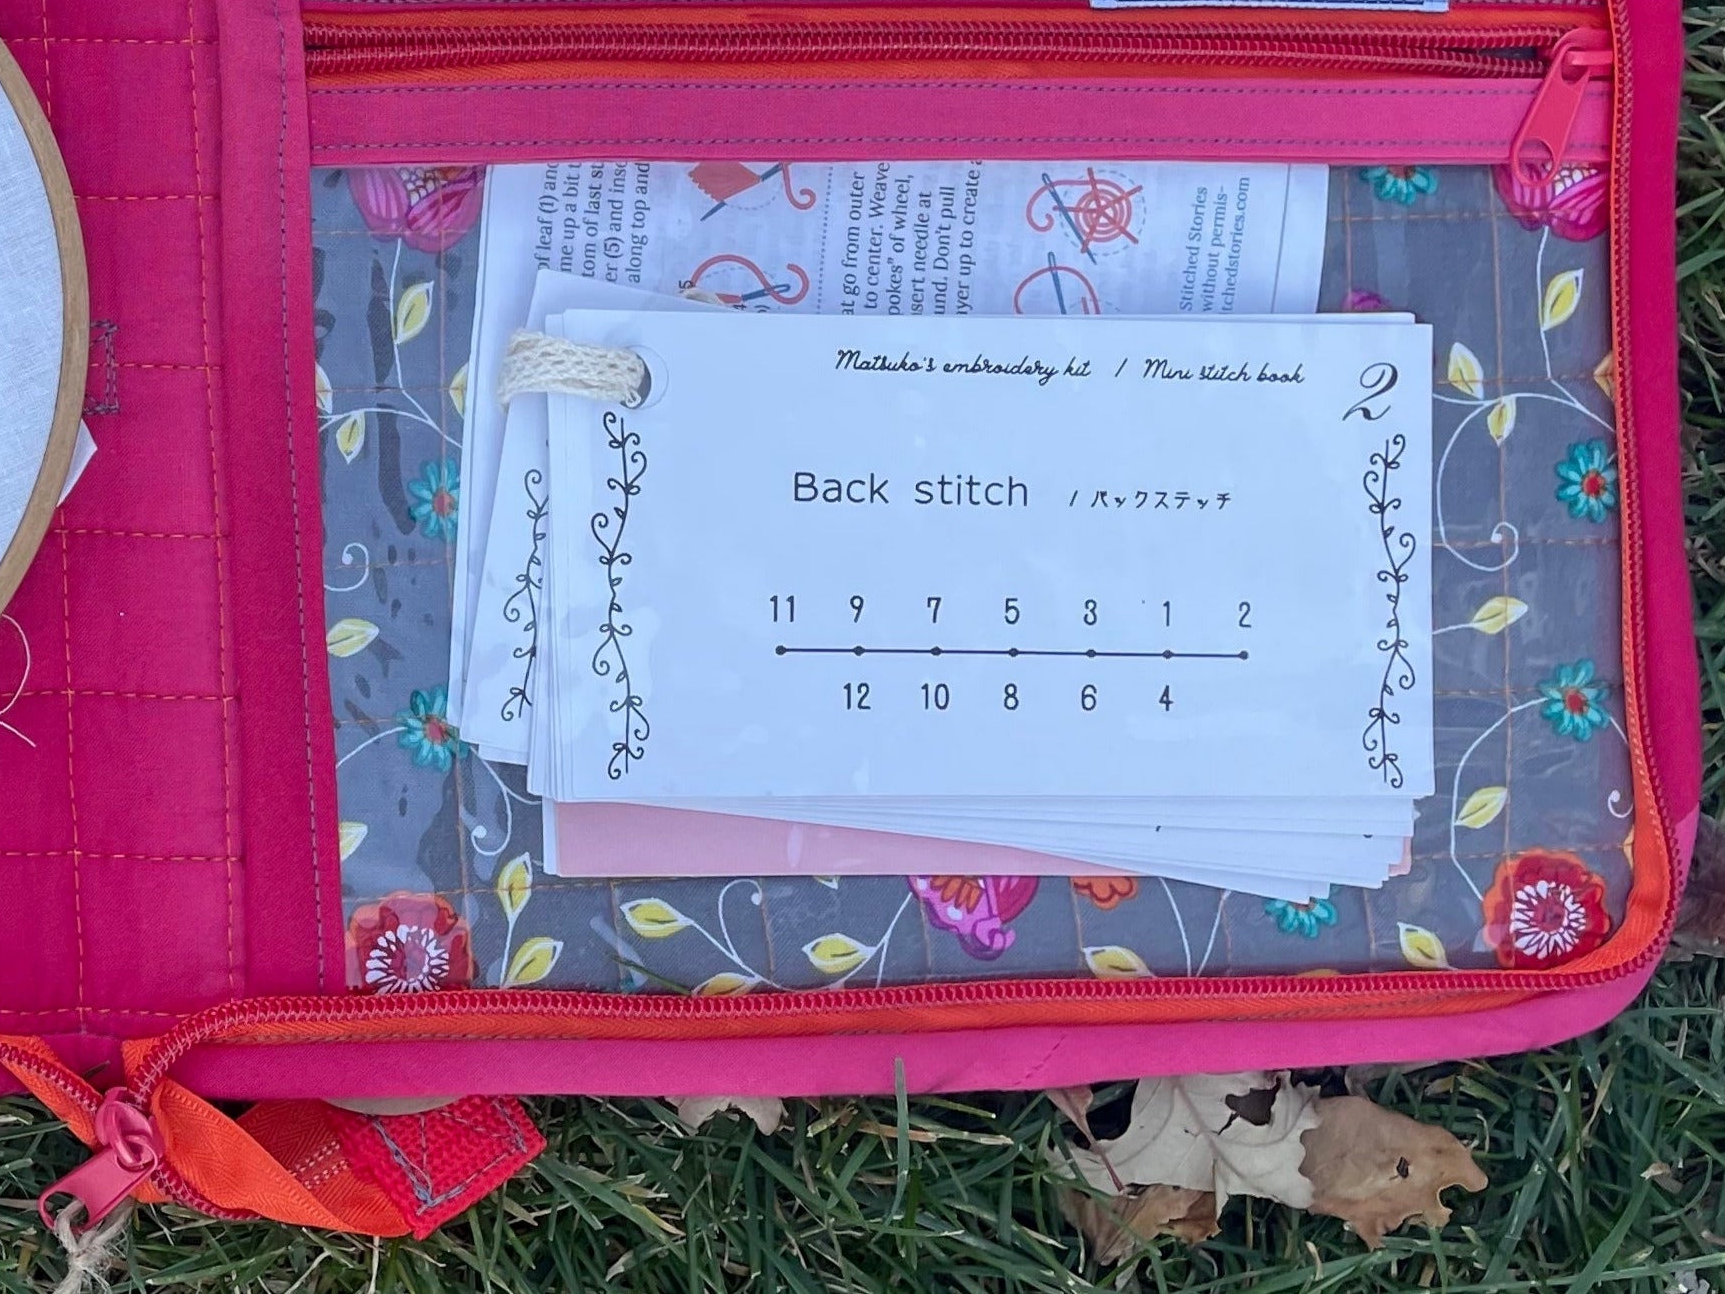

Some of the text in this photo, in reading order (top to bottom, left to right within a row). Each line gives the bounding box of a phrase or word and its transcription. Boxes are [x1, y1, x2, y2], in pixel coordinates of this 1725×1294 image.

[562, 172, 580, 198] bit
[584, 183, 602, 215] last
[849, 171, 865, 221] outer
[919, 191, 932, 208] at
[963, 170, 980, 225] create
[538, 195, 559, 214] (1)
[565, 203, 577, 213] a
[607, 200, 623, 232] and
[891, 174, 914, 231] wheel,
[939, 186, 957, 219] pull
[536, 216, 553, 250] leaf
[564, 217, 580, 240] up
[583, 217, 599, 237] of
[625, 162, 650, 283] along top and
[864, 162, 890, 309] to center. Weave
[603, 237, 624, 259] (5)
[841, 226, 860, 268] from
[889, 233, 905, 253] of
[914, 213, 930, 271] needle
[959, 230, 973, 248] to
[1179, 186, 1208, 312] Stitched Stories
[1201, 186, 1228, 313] without permis-
[1219, 177, 1250, 314] tchedstories.com
[959, 253, 976, 276] up
[843, 273, 860, 296] go
[1063, 356, 1092, 377] kit
[1143, 359, 1194, 380] Mini
[1199, 362, 1252, 382] stitch
[1257, 362, 1305, 384] book
[1342, 362, 1398, 421] 2
[794, 472, 890, 504] Back
[915, 474, 1029, 507] stitch
[769, 595, 1252, 628] 11 9 7 5 3 1 2
[843, 683, 1173, 711] 12 10 8 6 4
